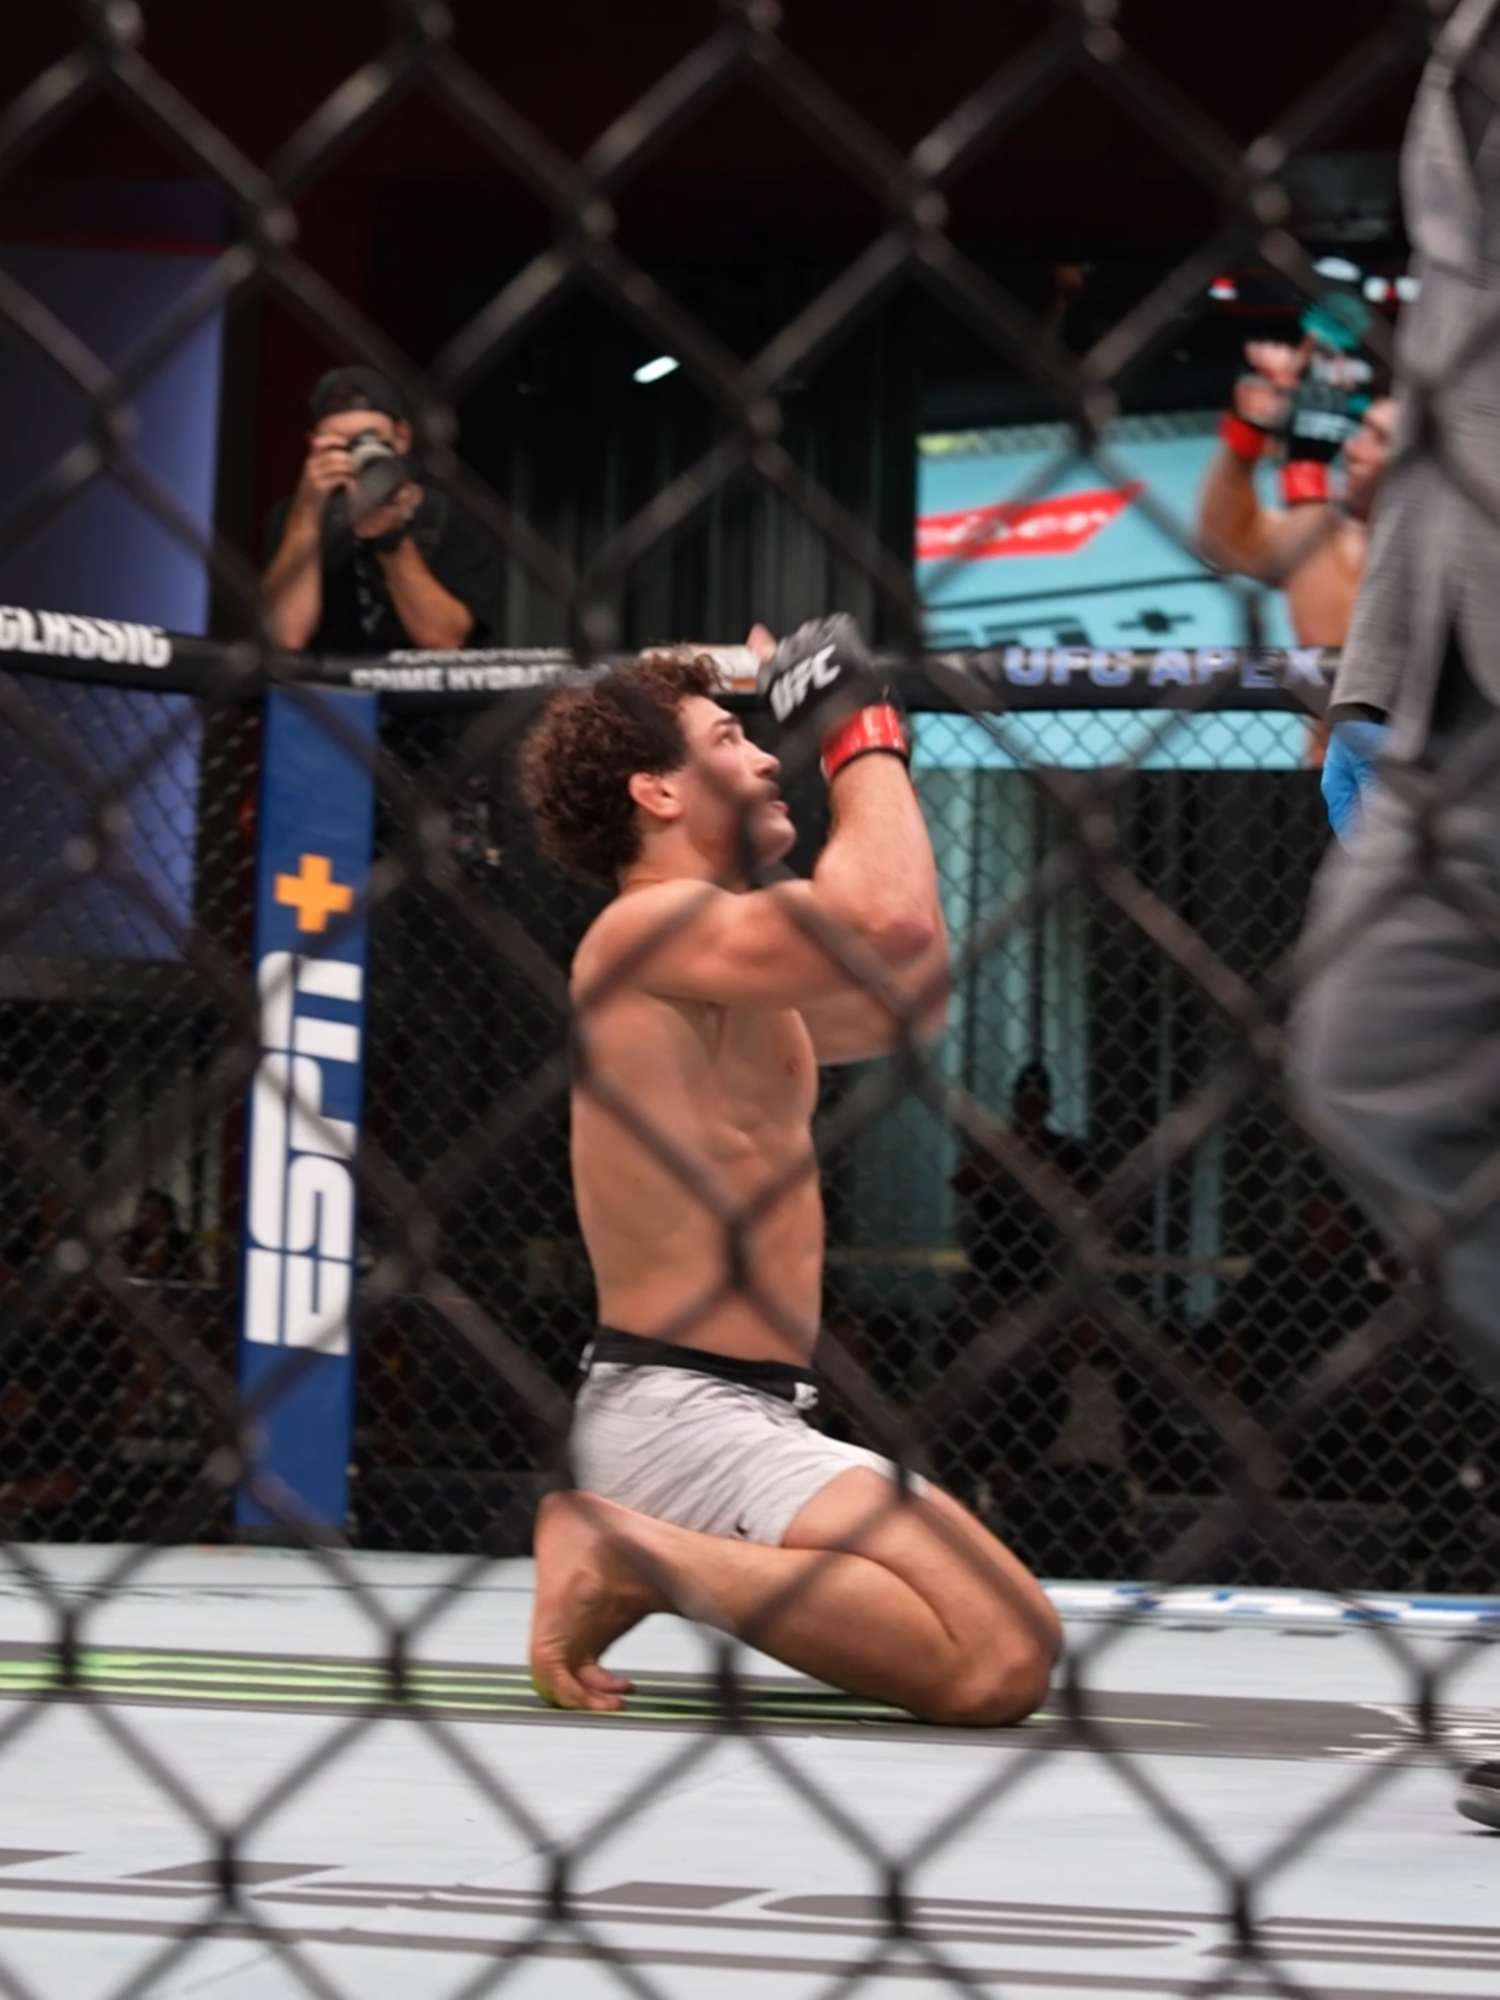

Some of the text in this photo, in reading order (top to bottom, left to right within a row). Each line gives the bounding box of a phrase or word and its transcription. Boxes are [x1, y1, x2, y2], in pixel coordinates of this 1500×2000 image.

[351, 667, 444, 692] PRIME
[770, 644, 842, 721] UFC
[1004, 646, 1325, 689] UFC APEX
